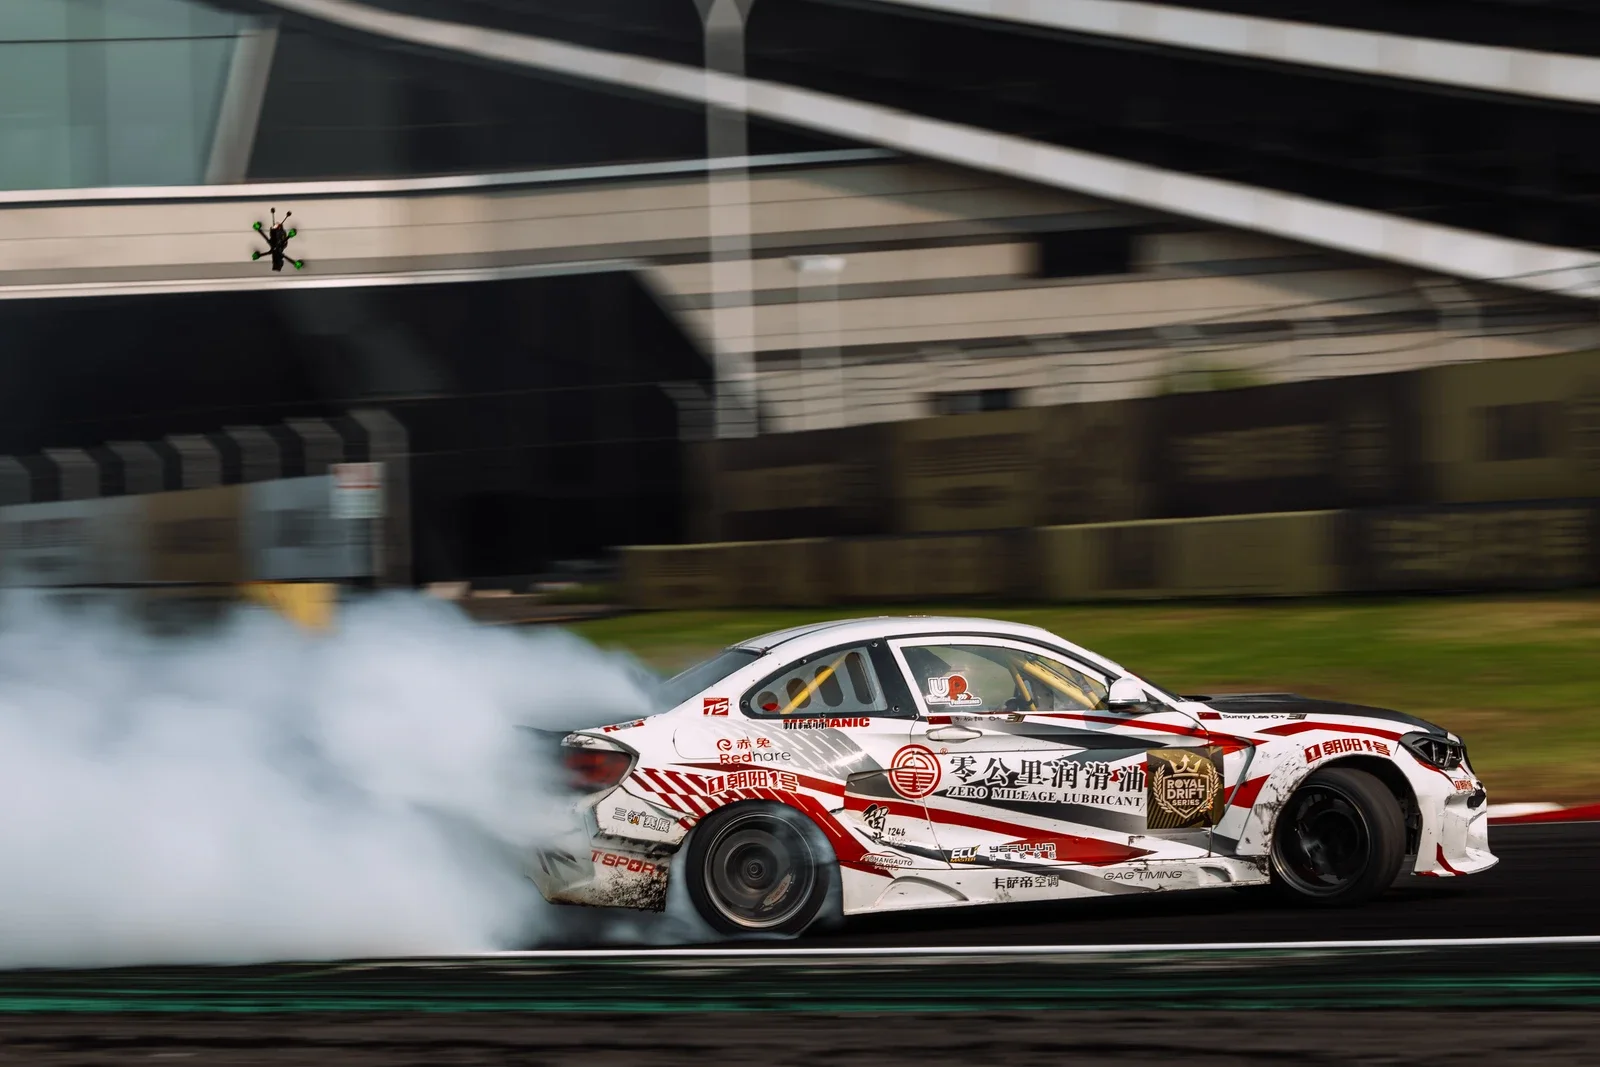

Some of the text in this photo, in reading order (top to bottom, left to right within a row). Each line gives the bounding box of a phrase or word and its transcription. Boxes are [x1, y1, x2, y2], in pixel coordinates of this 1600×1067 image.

[928, 675, 968, 700] UP
[737, 737, 772, 750] 赤兔
[720, 750, 791, 765] Redhare
[949, 755, 1147, 793] 零公里润滑油
[1167, 779, 1205, 789] ROYAL
[948, 786, 1143, 807] ZERO MILEAGE LUBRICANT
[1167, 789, 1205, 800] DRIFT
[951, 846, 979, 858] ECU
[993, 875, 1060, 890] 卡萨帝空调
